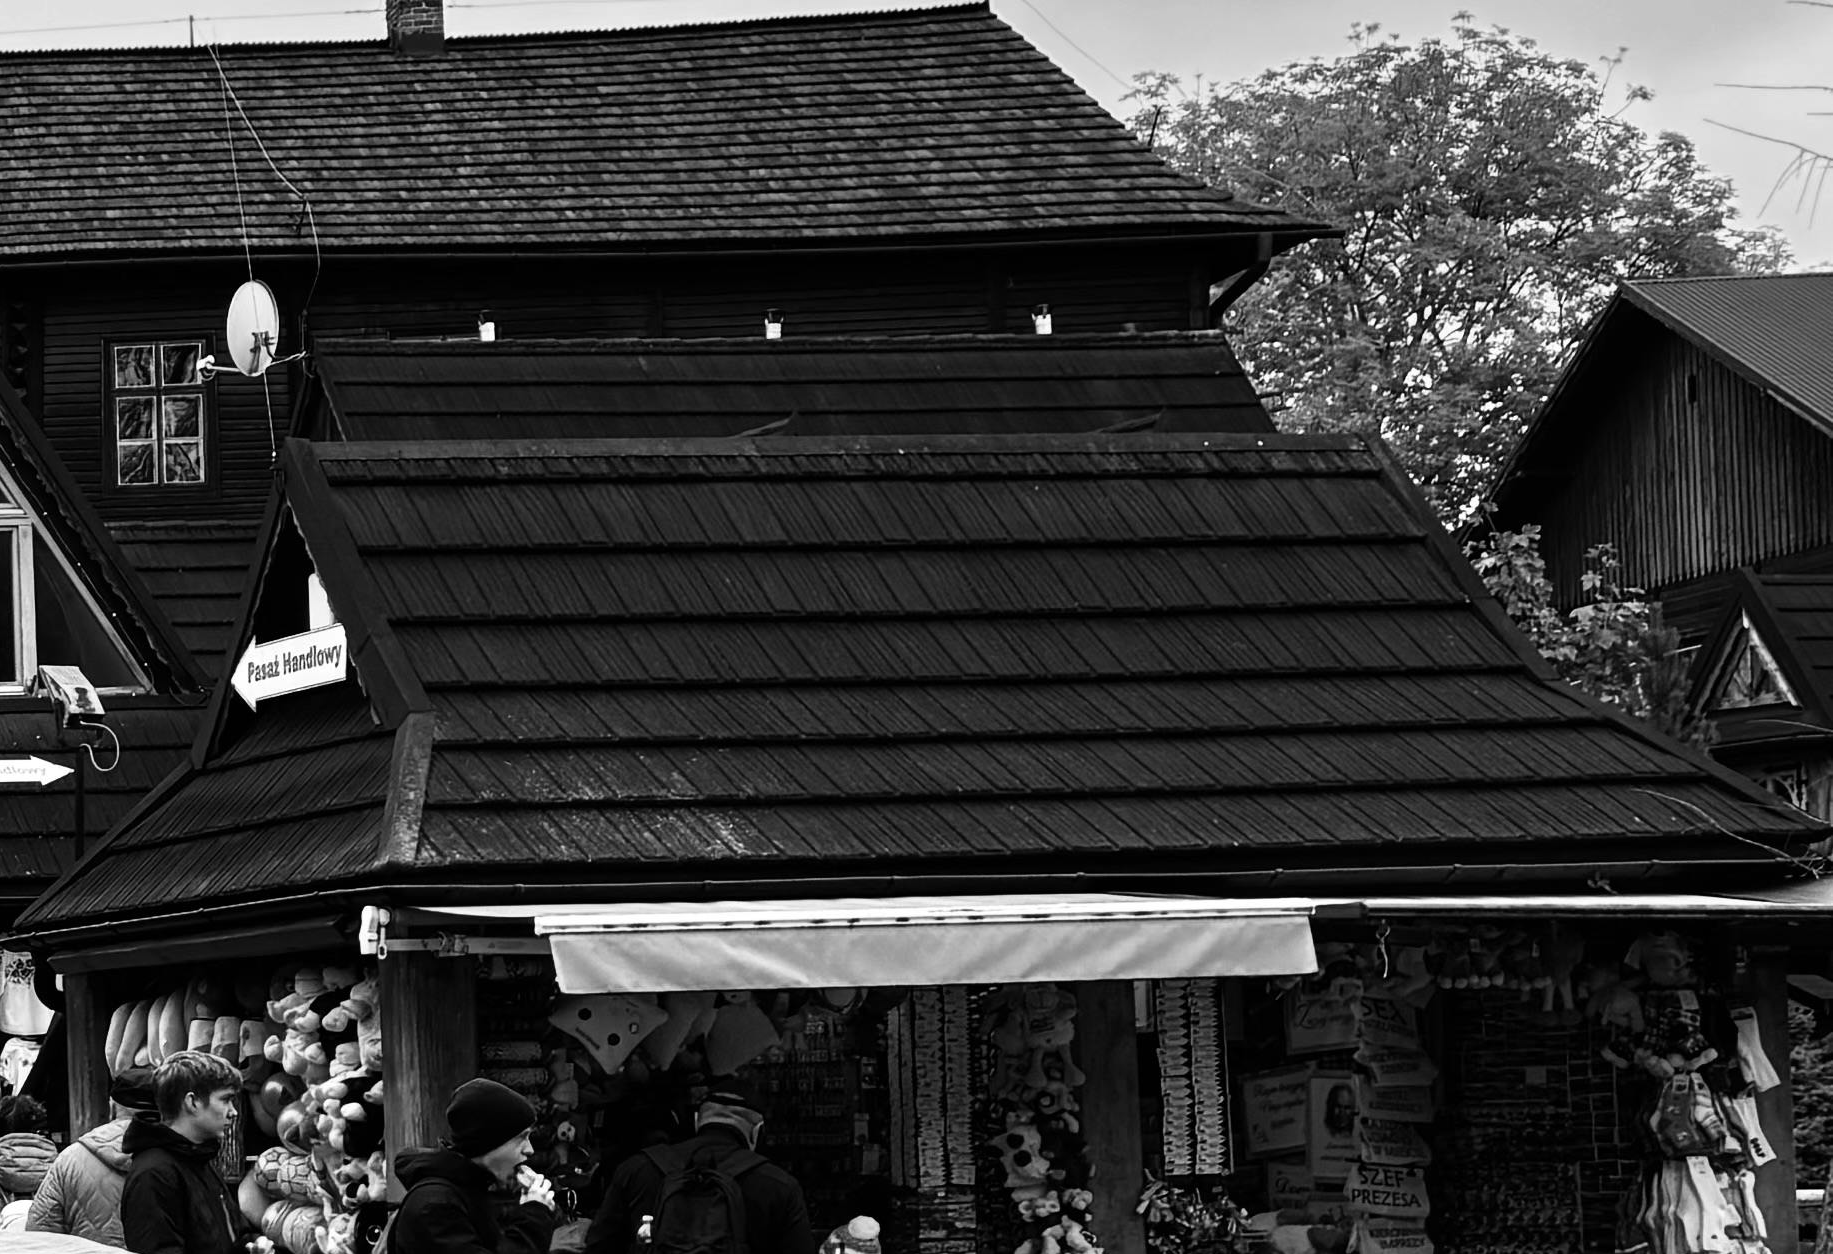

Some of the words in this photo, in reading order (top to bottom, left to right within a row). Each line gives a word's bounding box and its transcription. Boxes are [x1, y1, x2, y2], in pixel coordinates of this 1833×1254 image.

[247, 654, 281, 684] Pasaż
[283, 644, 342, 675] Handlowy
[1361, 1000, 1407, 1025] SEX
[1359, 1168, 1405, 1188] SZEF
[1351, 1188, 1422, 1208] PREZESA
